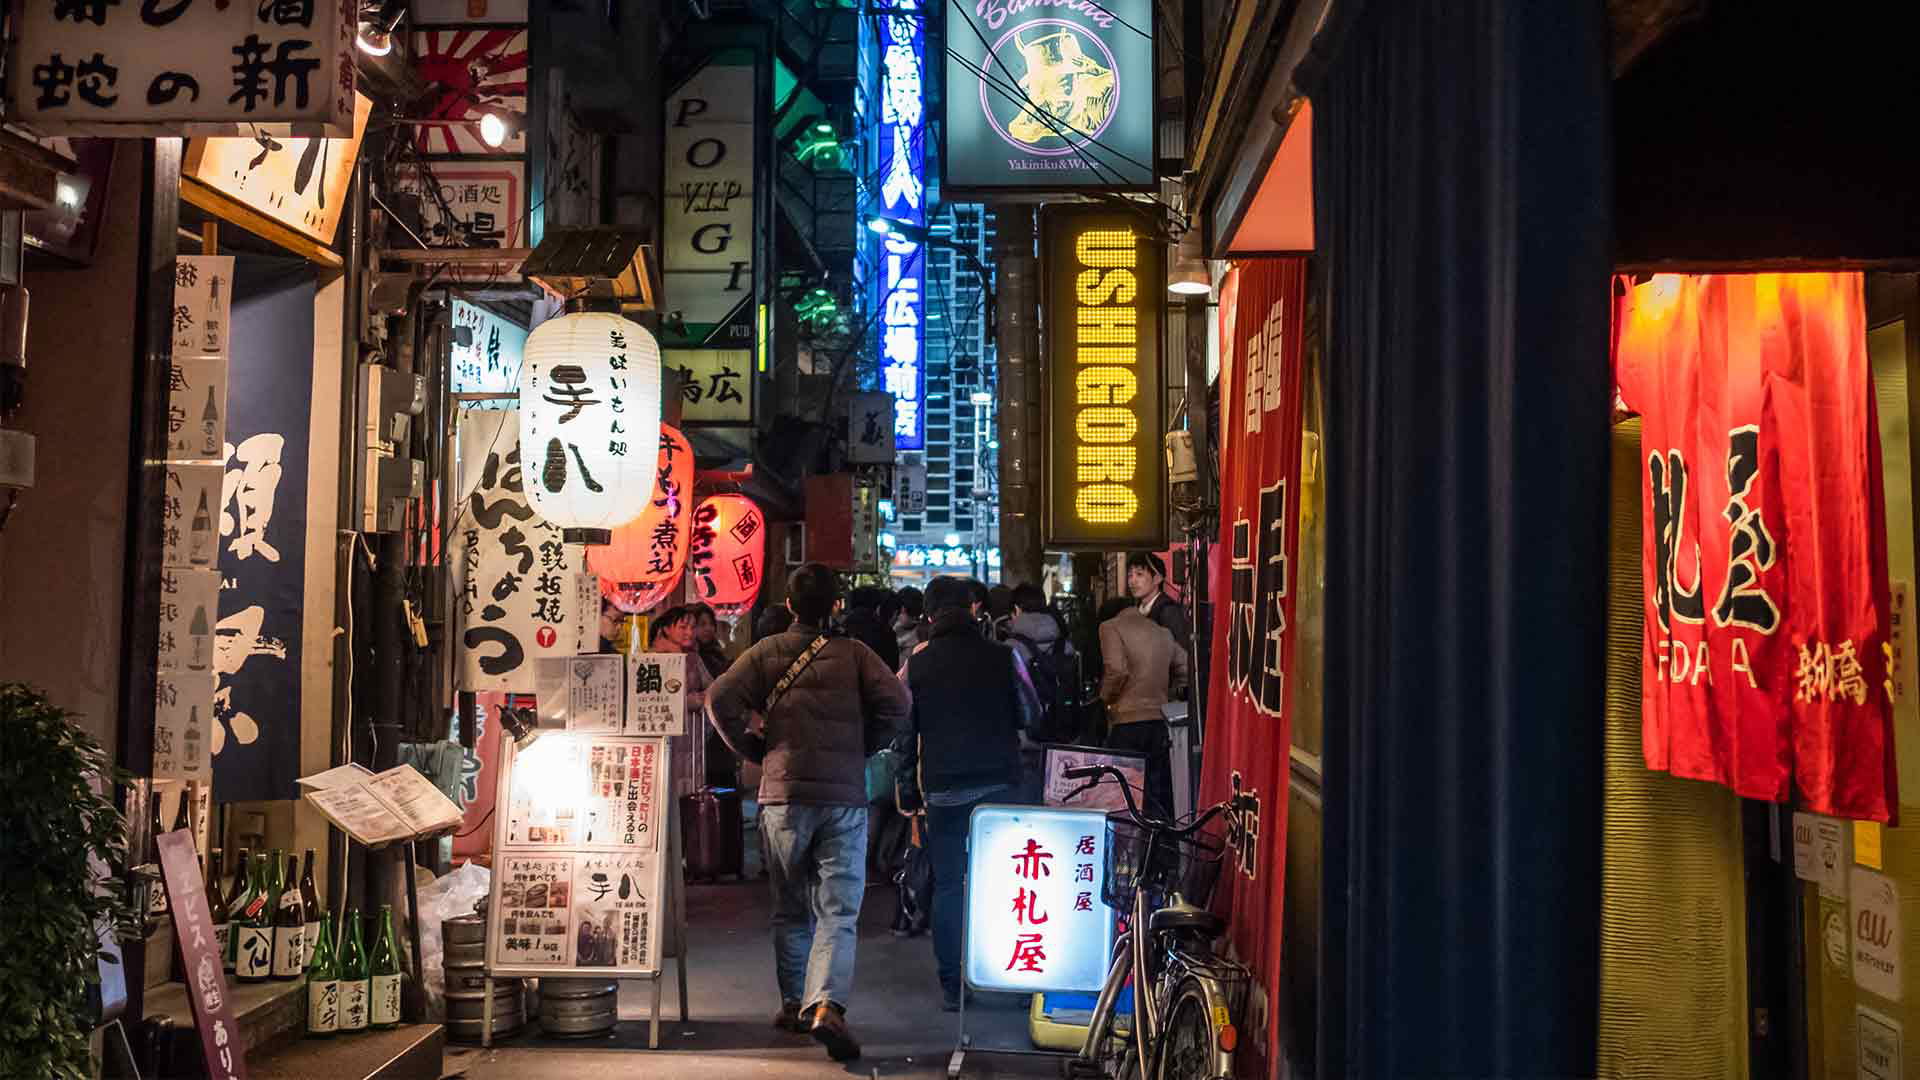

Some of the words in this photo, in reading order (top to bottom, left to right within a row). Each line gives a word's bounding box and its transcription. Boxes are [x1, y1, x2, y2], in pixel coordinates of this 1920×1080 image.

[33, 34, 321, 112] 蛇の新
[729, 324, 751, 337] PUB
[1075, 230, 1138, 523] USHIGORO
[636, 663, 663, 694] 鍋
[1005, 838, 1054, 973] 赤札屋
[1072, 835, 1097, 912] 居酒屋
